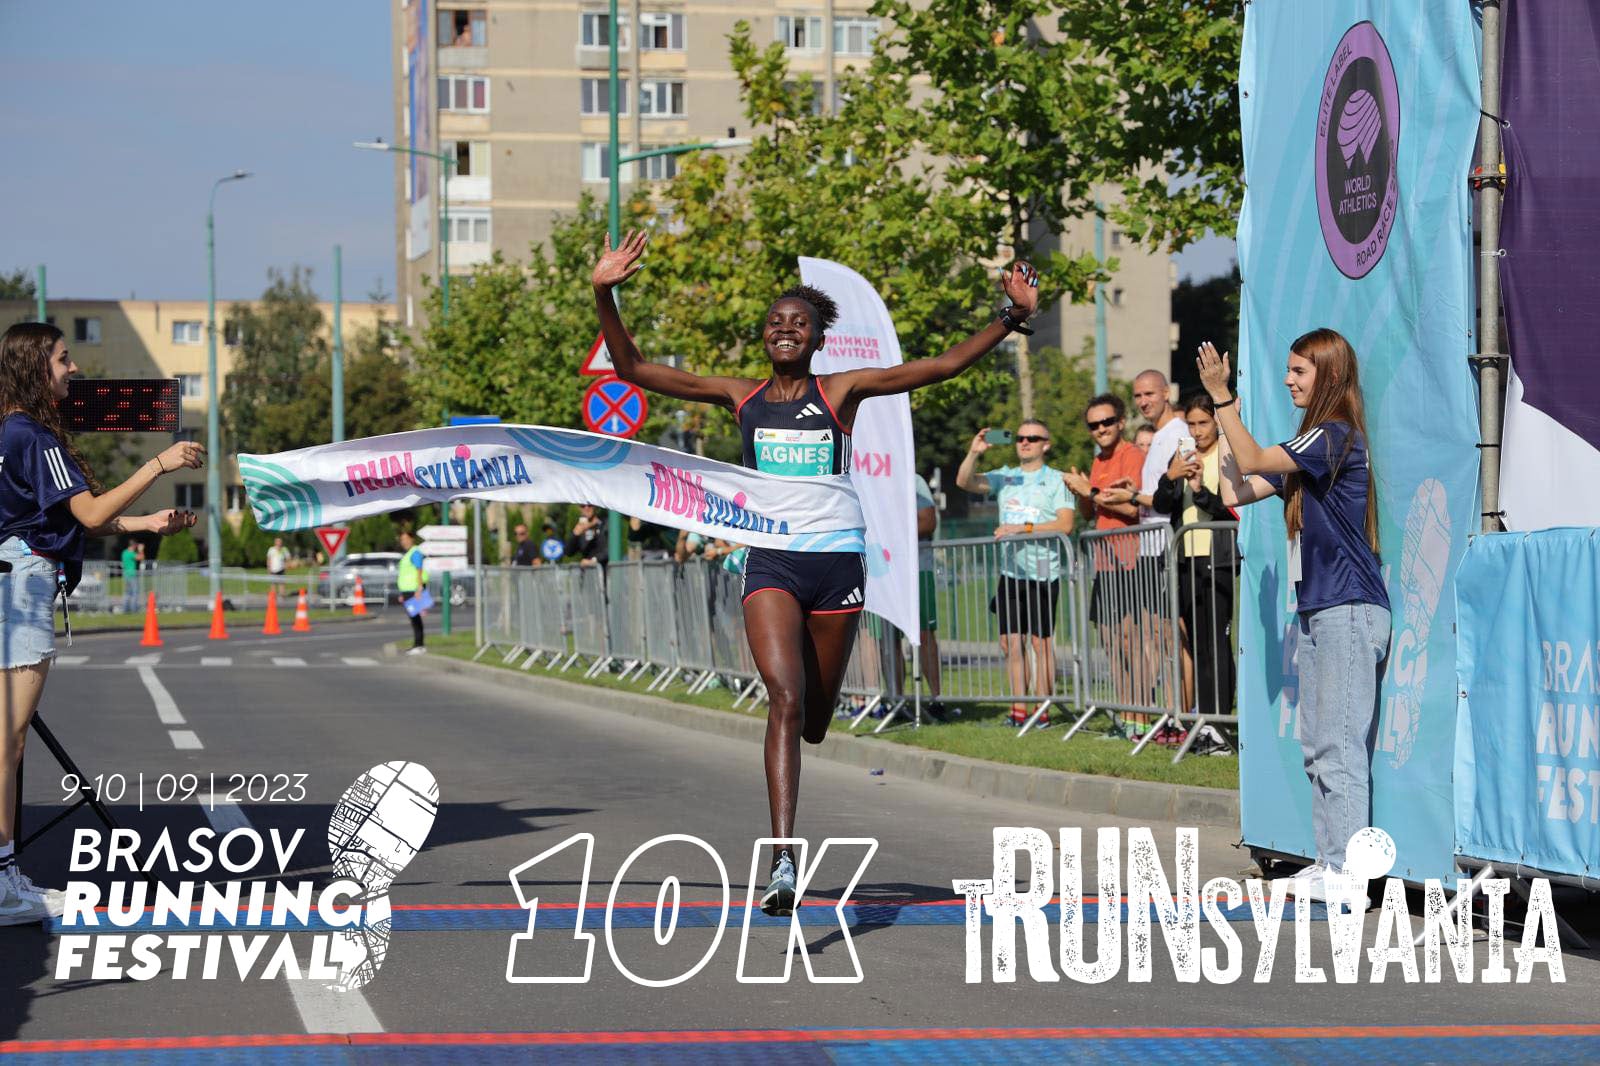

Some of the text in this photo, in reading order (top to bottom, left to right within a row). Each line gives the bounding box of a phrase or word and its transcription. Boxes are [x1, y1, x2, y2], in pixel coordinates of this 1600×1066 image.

[1319, 42, 1353, 138] ELITE LABEL
[1344, 174, 1372, 195] WORLD
[1338, 191, 1377, 216] ATHLETICS
[1356, 239, 1377, 267] ROAD
[1376, 195, 1394, 245] RACE
[760, 445, 831, 465] AGNES
[816, 464, 830, 476] 31
